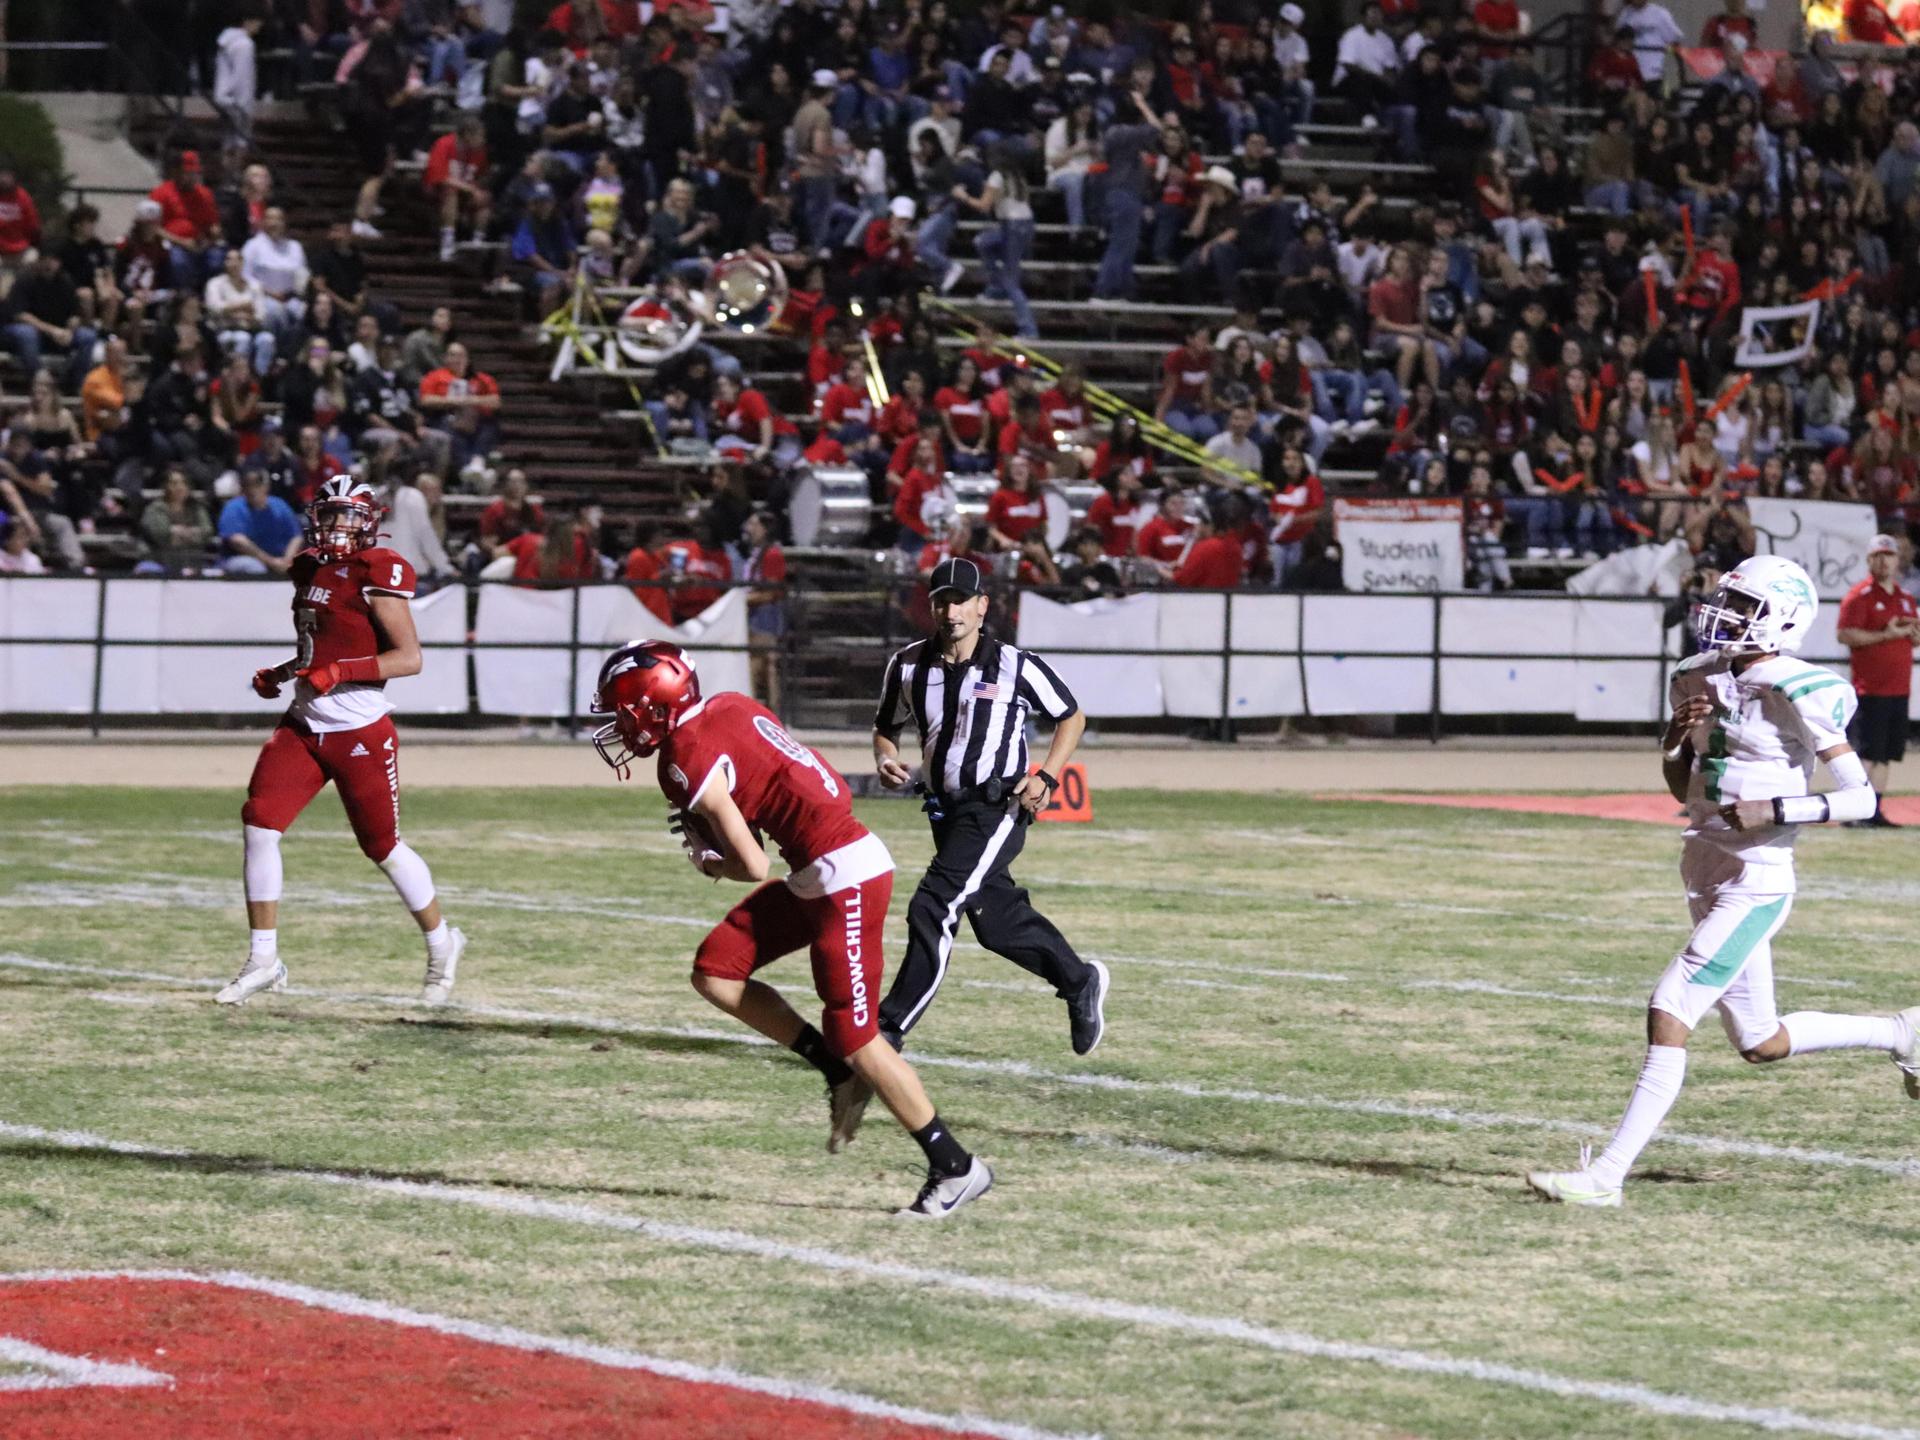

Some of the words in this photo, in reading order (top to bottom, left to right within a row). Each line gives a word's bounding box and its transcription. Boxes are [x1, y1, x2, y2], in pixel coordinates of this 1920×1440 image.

[1358, 537, 1441, 560] Student
[1751, 508, 1859, 589] Tbe
[389, 563, 403, 587] 5
[307, 585, 333, 605] IBE
[1831, 697, 1845, 728] 4
[752, 715, 840, 798] 9
[667, 763, 690, 791] 9
[845, 884, 869, 1028] CHOWCHILL
